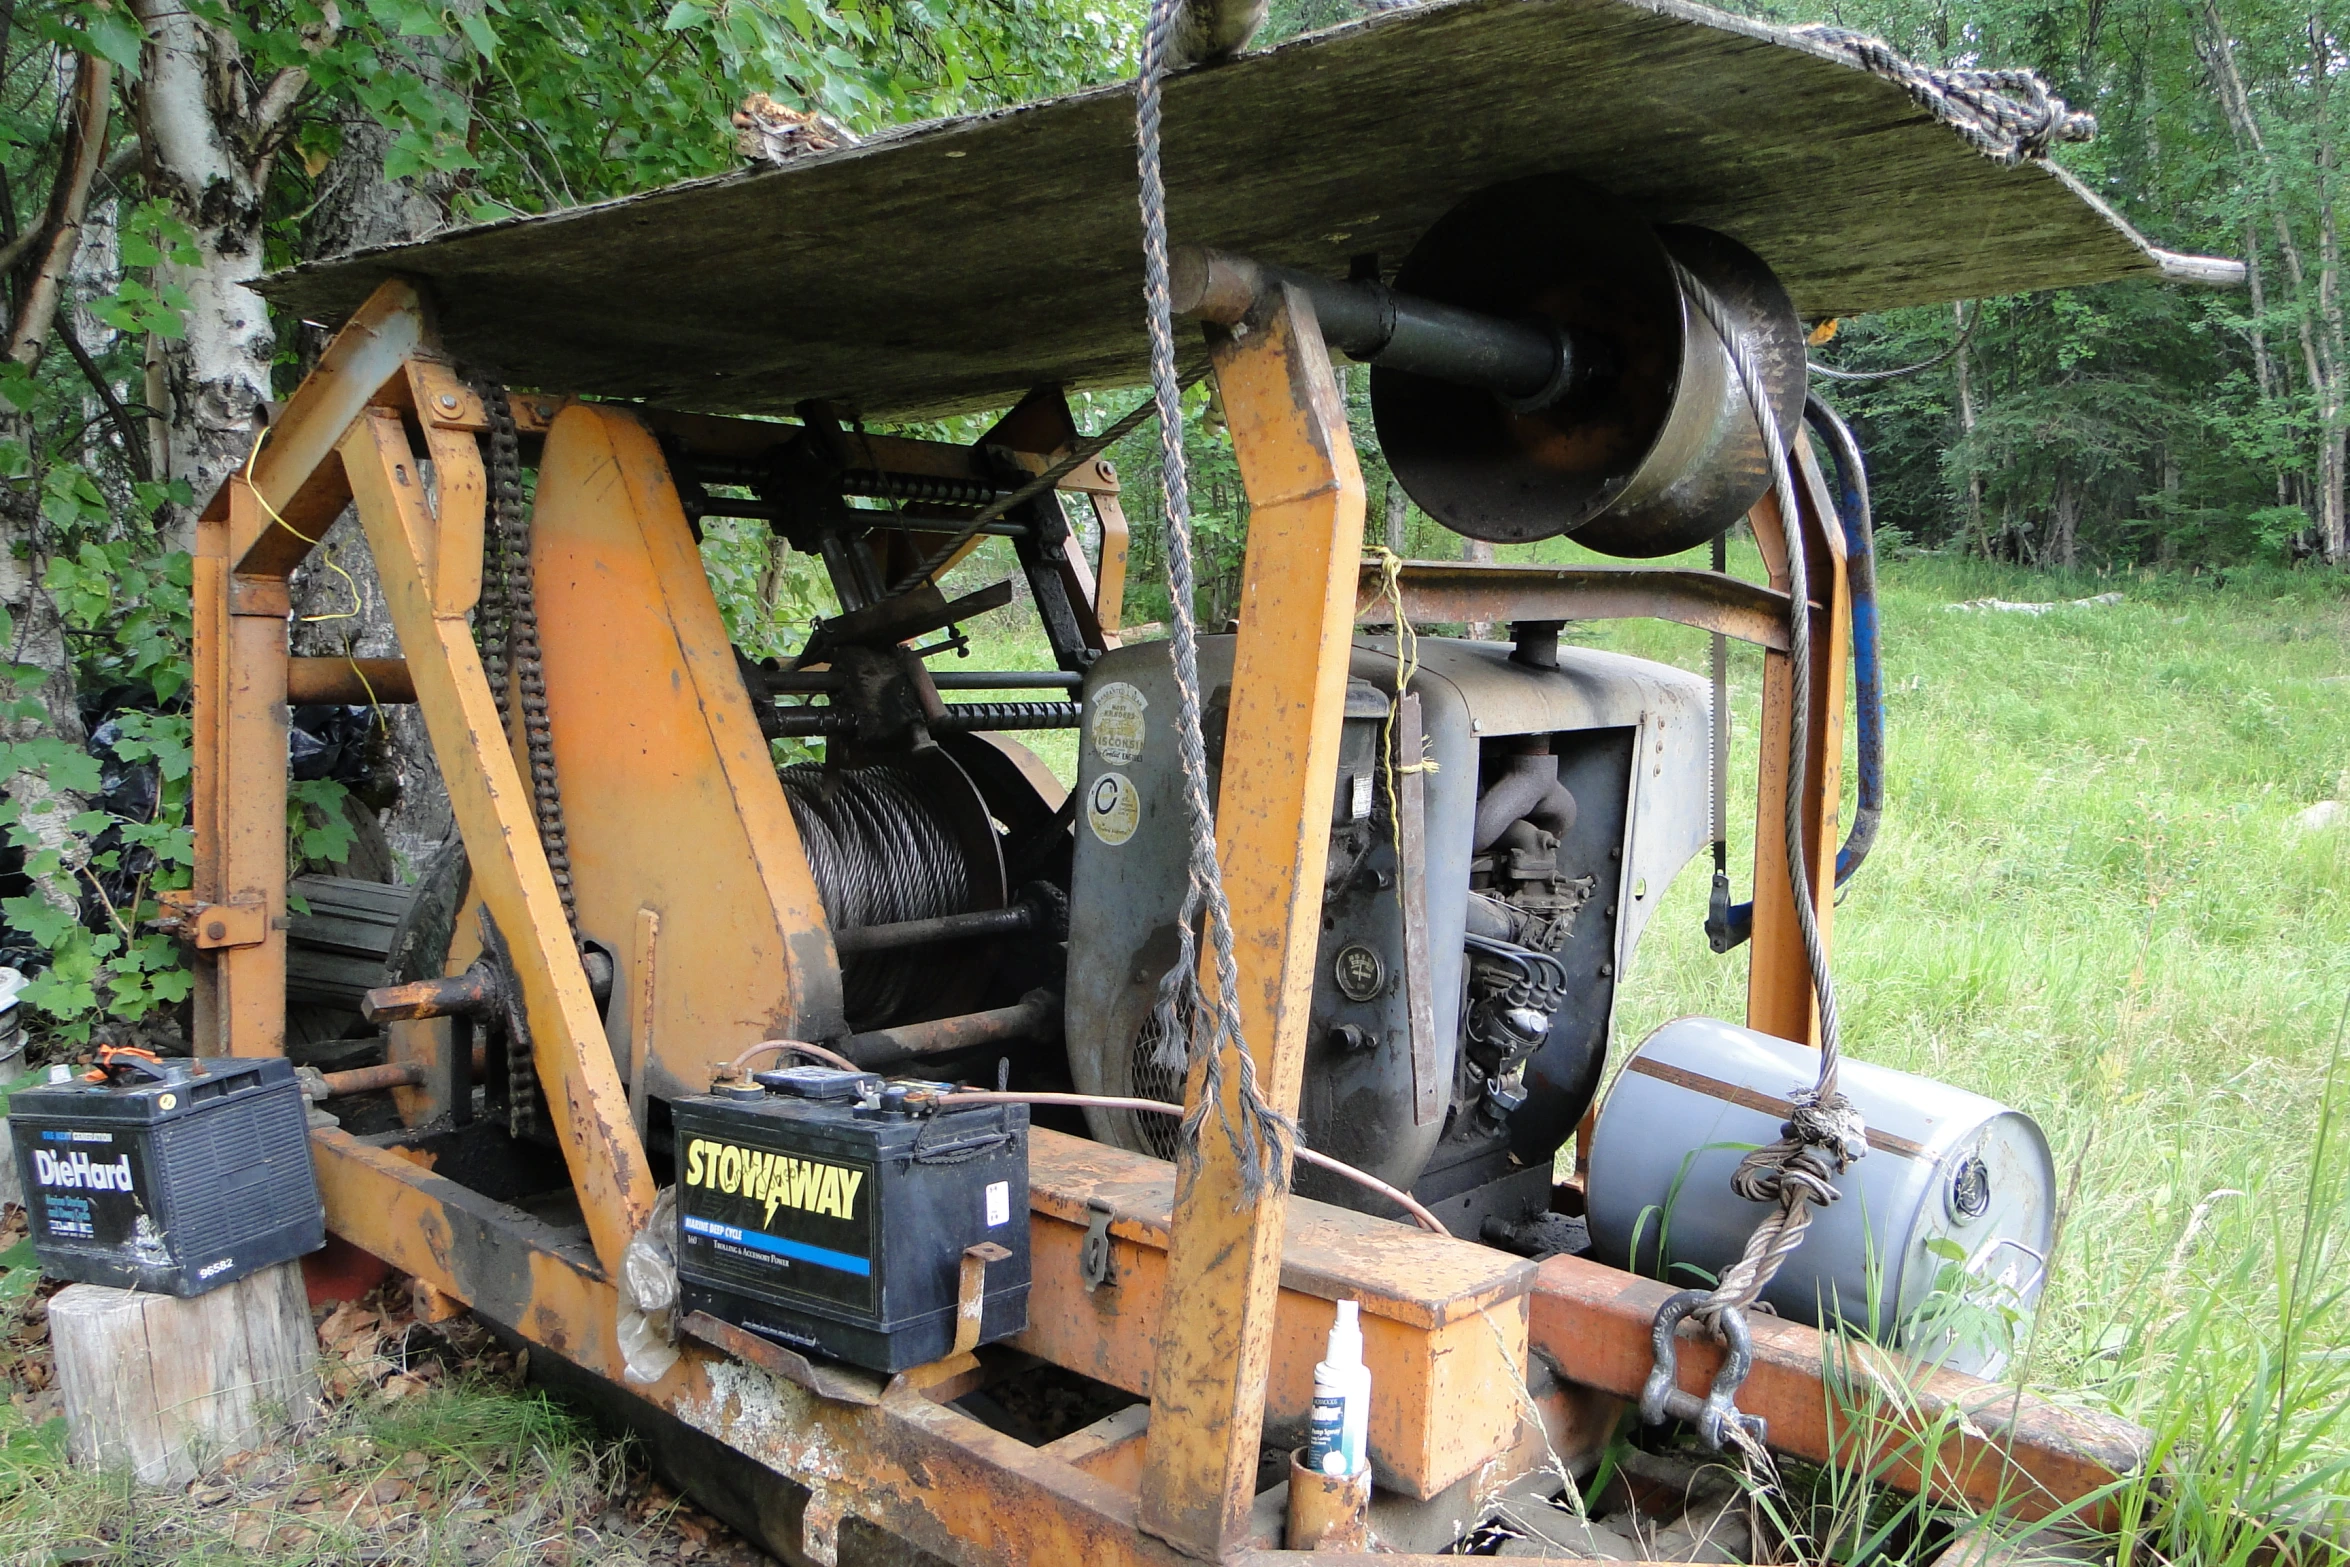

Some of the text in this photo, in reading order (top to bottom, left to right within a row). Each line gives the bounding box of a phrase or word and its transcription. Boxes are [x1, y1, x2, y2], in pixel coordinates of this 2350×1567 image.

[1090, 735, 1145, 749] WISCONSIN
[34, 1149, 134, 1192] DieHard
[686, 1138, 864, 1221] STOWAWAY
[685, 1217, 742, 1241] MARINE DEEP CYCLE
[200, 1258, 234, 1279] 96582
